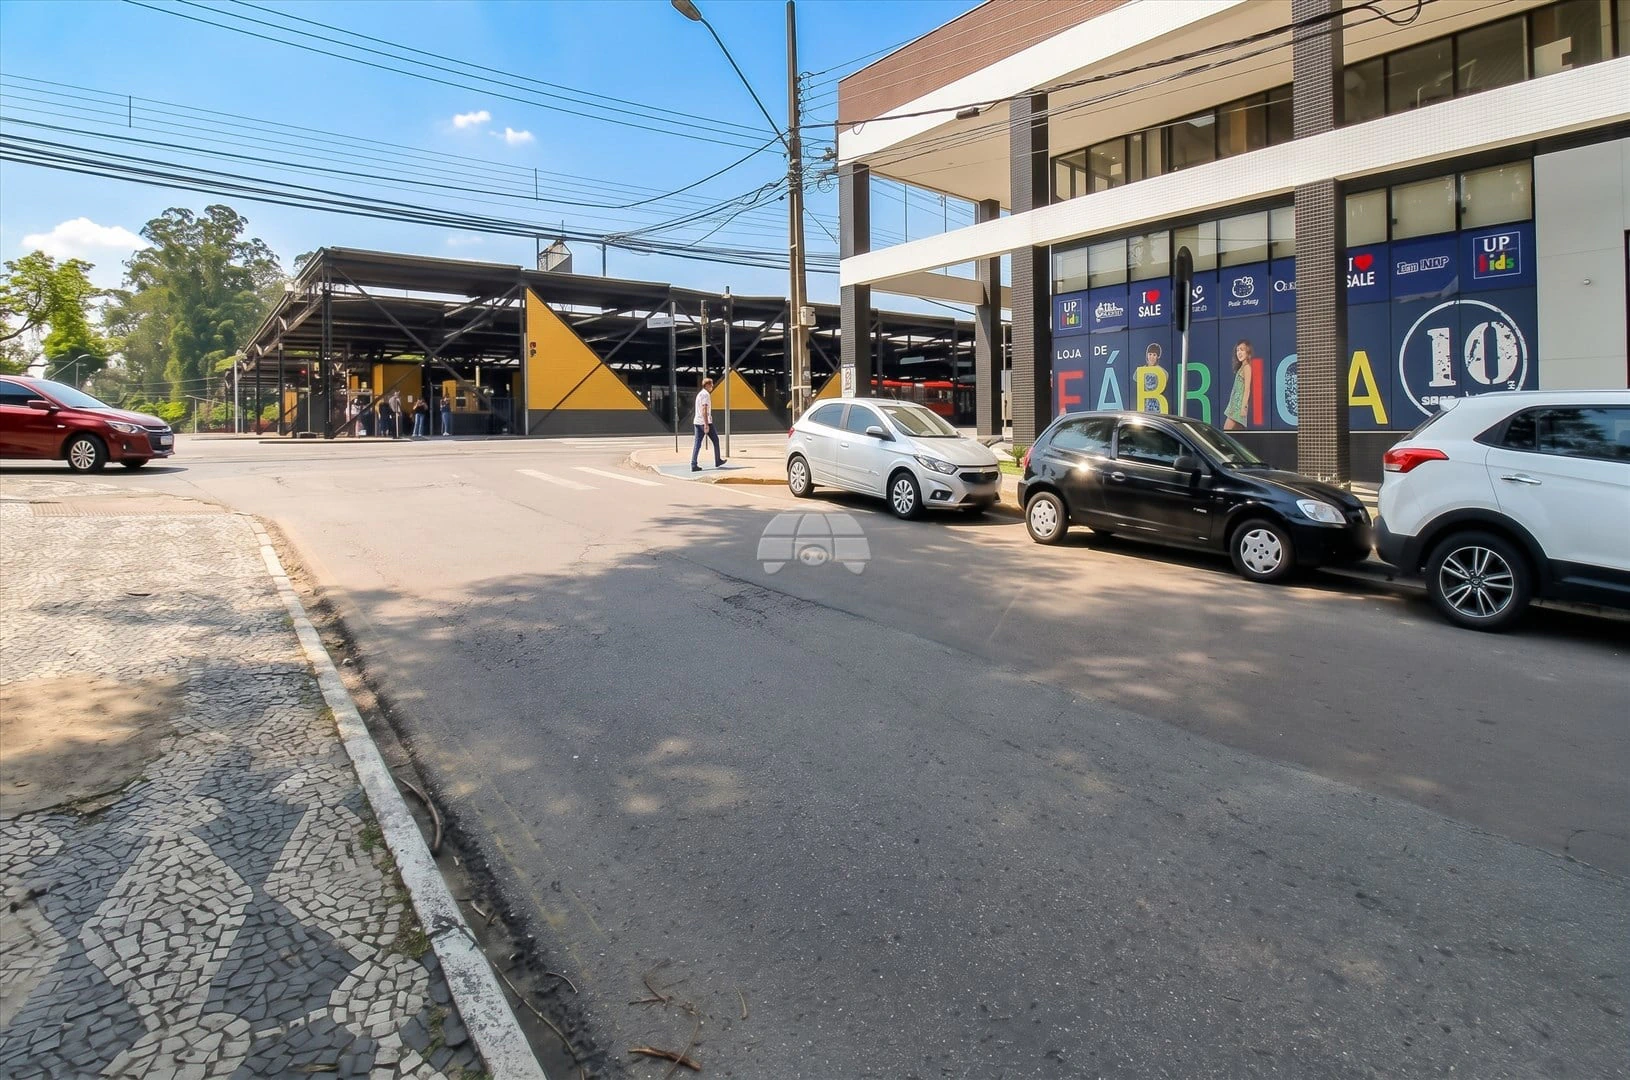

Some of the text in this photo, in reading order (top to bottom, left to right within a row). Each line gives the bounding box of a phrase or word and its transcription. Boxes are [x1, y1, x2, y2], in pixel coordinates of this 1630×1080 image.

[1483, 235, 1510, 252] UP
[1348, 257, 1354, 272] I
[1347, 271, 1375, 288] SALE
[1142, 292, 1147, 304] I
[1064, 301, 1078, 313] UP
[1138, 304, 1162, 318] SALE
[1057, 345, 1107, 360] LOJA DE
[1427, 321, 1518, 387] 10
